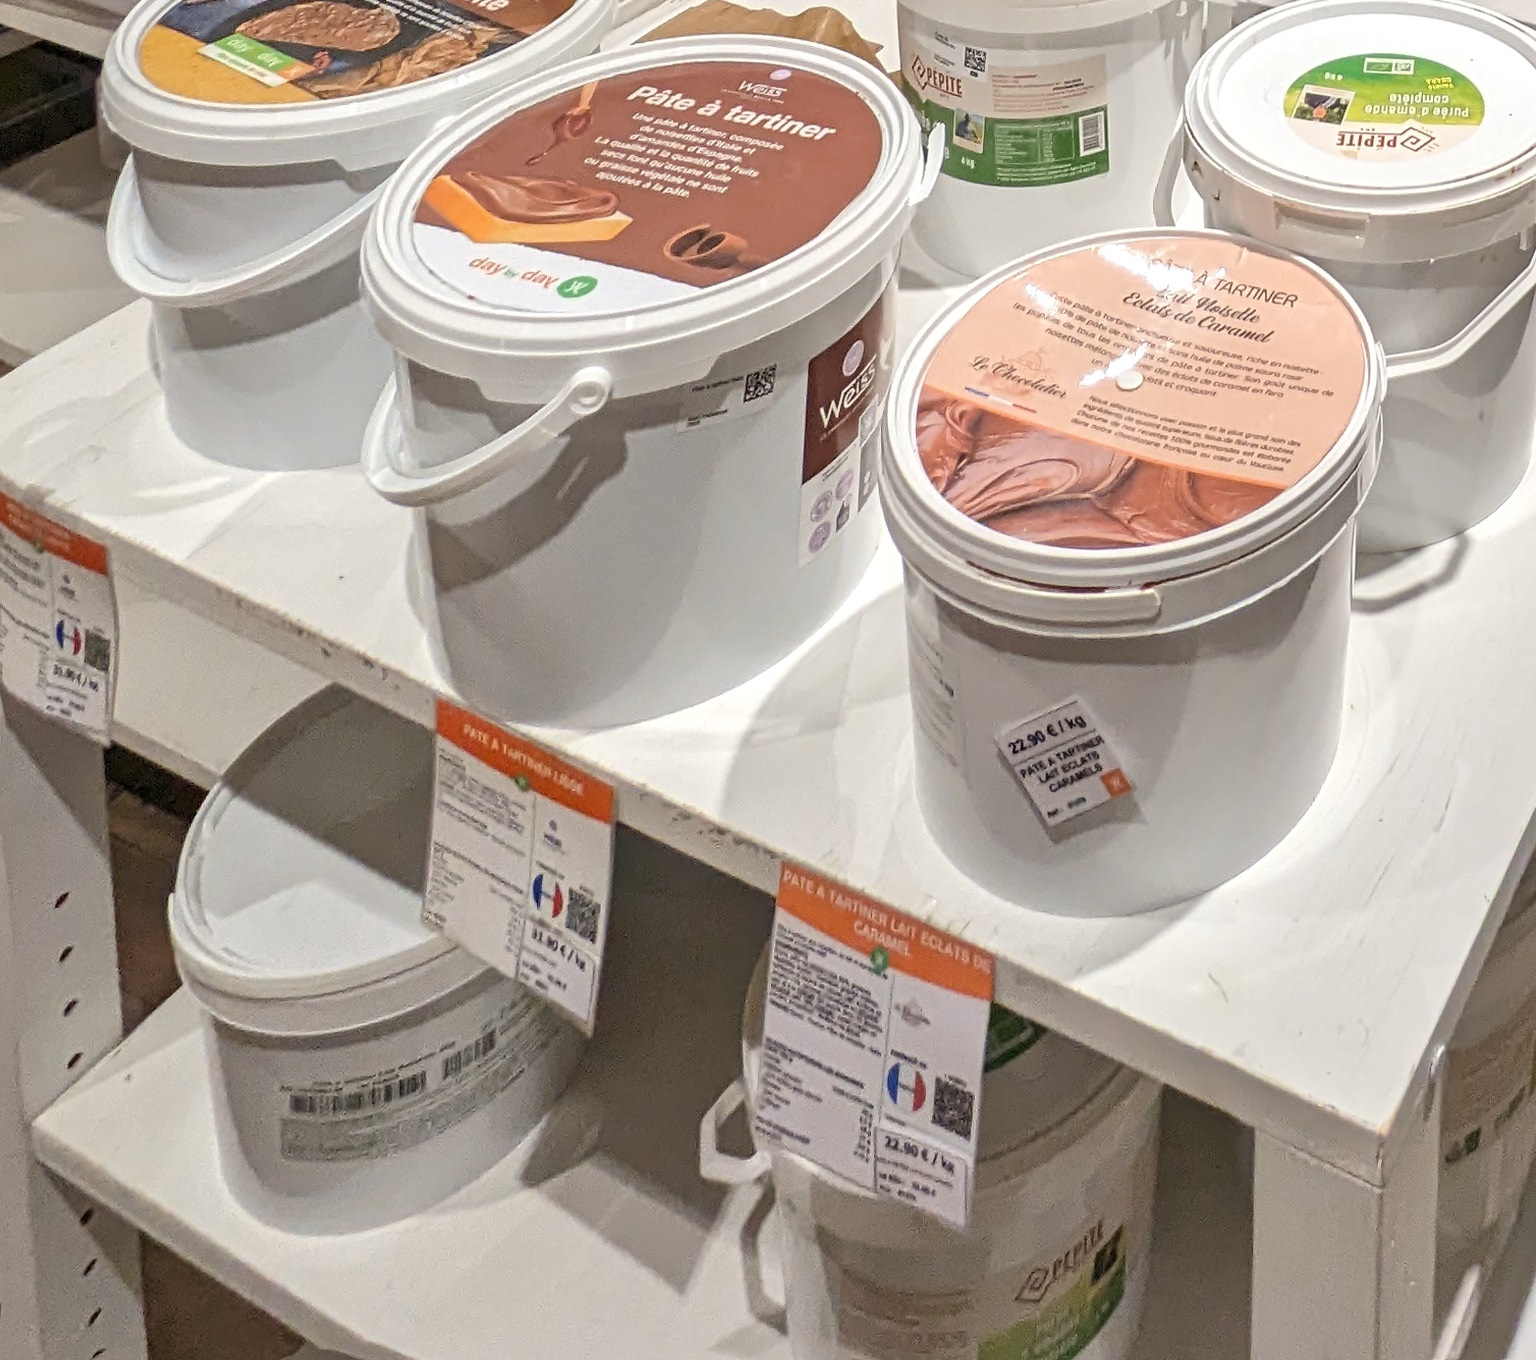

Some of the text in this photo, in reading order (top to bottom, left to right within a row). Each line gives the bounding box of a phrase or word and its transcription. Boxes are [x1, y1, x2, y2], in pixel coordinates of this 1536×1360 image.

[626, 84, 697, 111] Pâte
[695, 99, 723, 117] à
[723, 104, 837, 142] tartiner
[1388, 92, 1450, 106] complète
[1432, 106, 1470, 119] Purée
[628, 132, 687, 152] d'amandes
[632, 111, 655, 124] Une
[655, 116, 680, 130] pâte
[729, 132, 785, 152] composée
[639, 124, 653, 134] de
[653, 127, 707, 146] noisettes
[743, 144, 757, 156] et
[1335, 132, 1398, 152] PÉPITE
[594, 135, 609, 147] La
[609, 138, 647, 156] qualité
[670, 151, 716, 169] quantité
[731, 163, 761, 180] fruits
[595, 170, 642, 189] ajoutées
[597, 158, 641, 176] graisse
[639, 167, 686, 186] végétale
[701, 182, 730, 196] sont
[468, 256, 508, 276] day
[521, 269, 560, 289] day
[1193, 269, 1299, 310] À TARTINER
[1086, 318, 1109, 332] pâte
[1173, 309, 1196, 325] de
[1196, 315, 1276, 344] Caramel
[1196, 296, 1261, 325] Noisette
[1072, 301, 1095, 314] pâte
[1245, 354, 1269, 367] riche
[1075, 325, 1097, 340] tous
[1097, 333, 1112, 346] les
[1170, 359, 1194, 372] pâte
[1288, 383, 1320, 395] unique
[1320, 388, 1335, 398] de
[991, 361, 1067, 399] Chocolatier
[1212, 380, 1251, 393] caramel
[1008, 729, 1046, 755] 22.90
[1045, 723, 1060, 739] €
[1064, 714, 1088, 730] kg
[1018, 760, 1047, 781] PATE
[1047, 757, 1057, 769] A
[782, 868, 815, 894] PATE
[815, 884, 827, 900] A
[828, 889, 888, 930] TARTINER
[852, 920, 912, 961] CARAMEL
